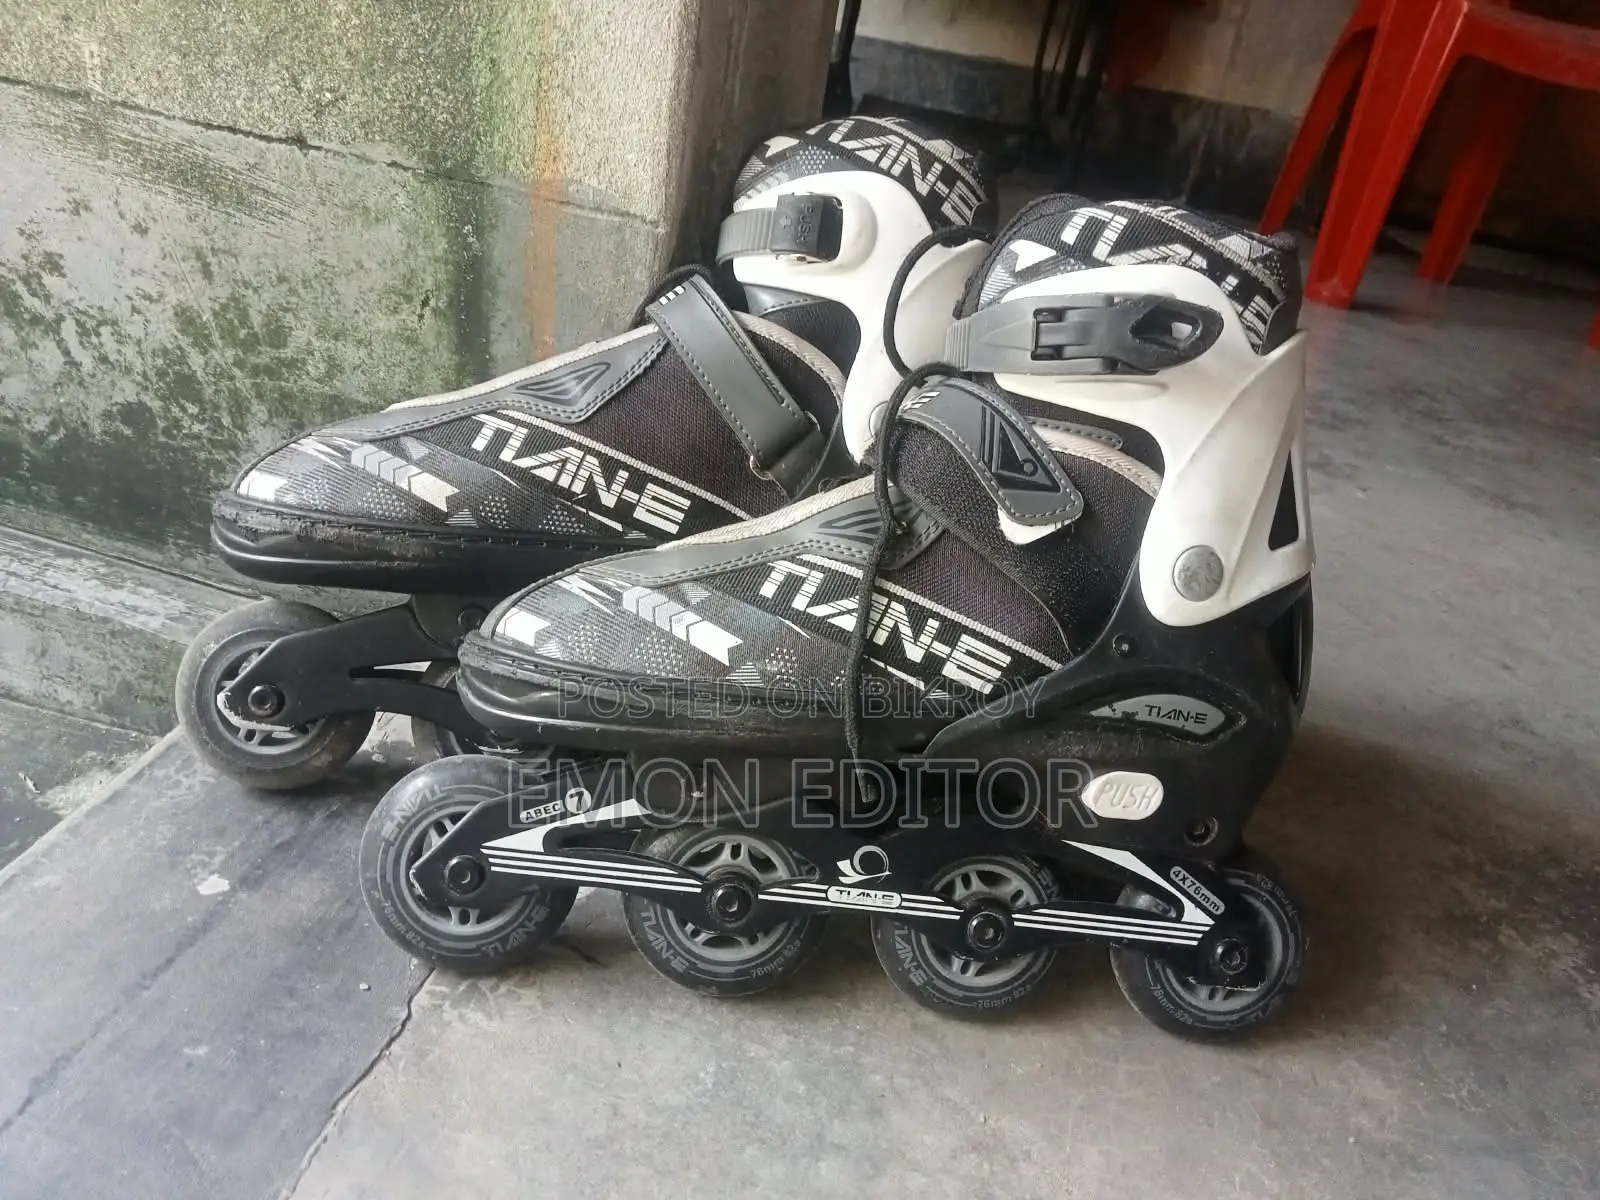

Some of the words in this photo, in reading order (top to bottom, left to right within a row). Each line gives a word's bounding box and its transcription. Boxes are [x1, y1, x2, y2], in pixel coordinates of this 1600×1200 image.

[806, 119, 982, 226] TIAN-E
[471, 412, 692, 534] TIAN-E
[1145, 704, 1208, 724] TIAN-E
[525, 803, 561, 821] ABEC
[568, 790, 585, 812] 7
[1097, 782, 1159, 811] PUSH
